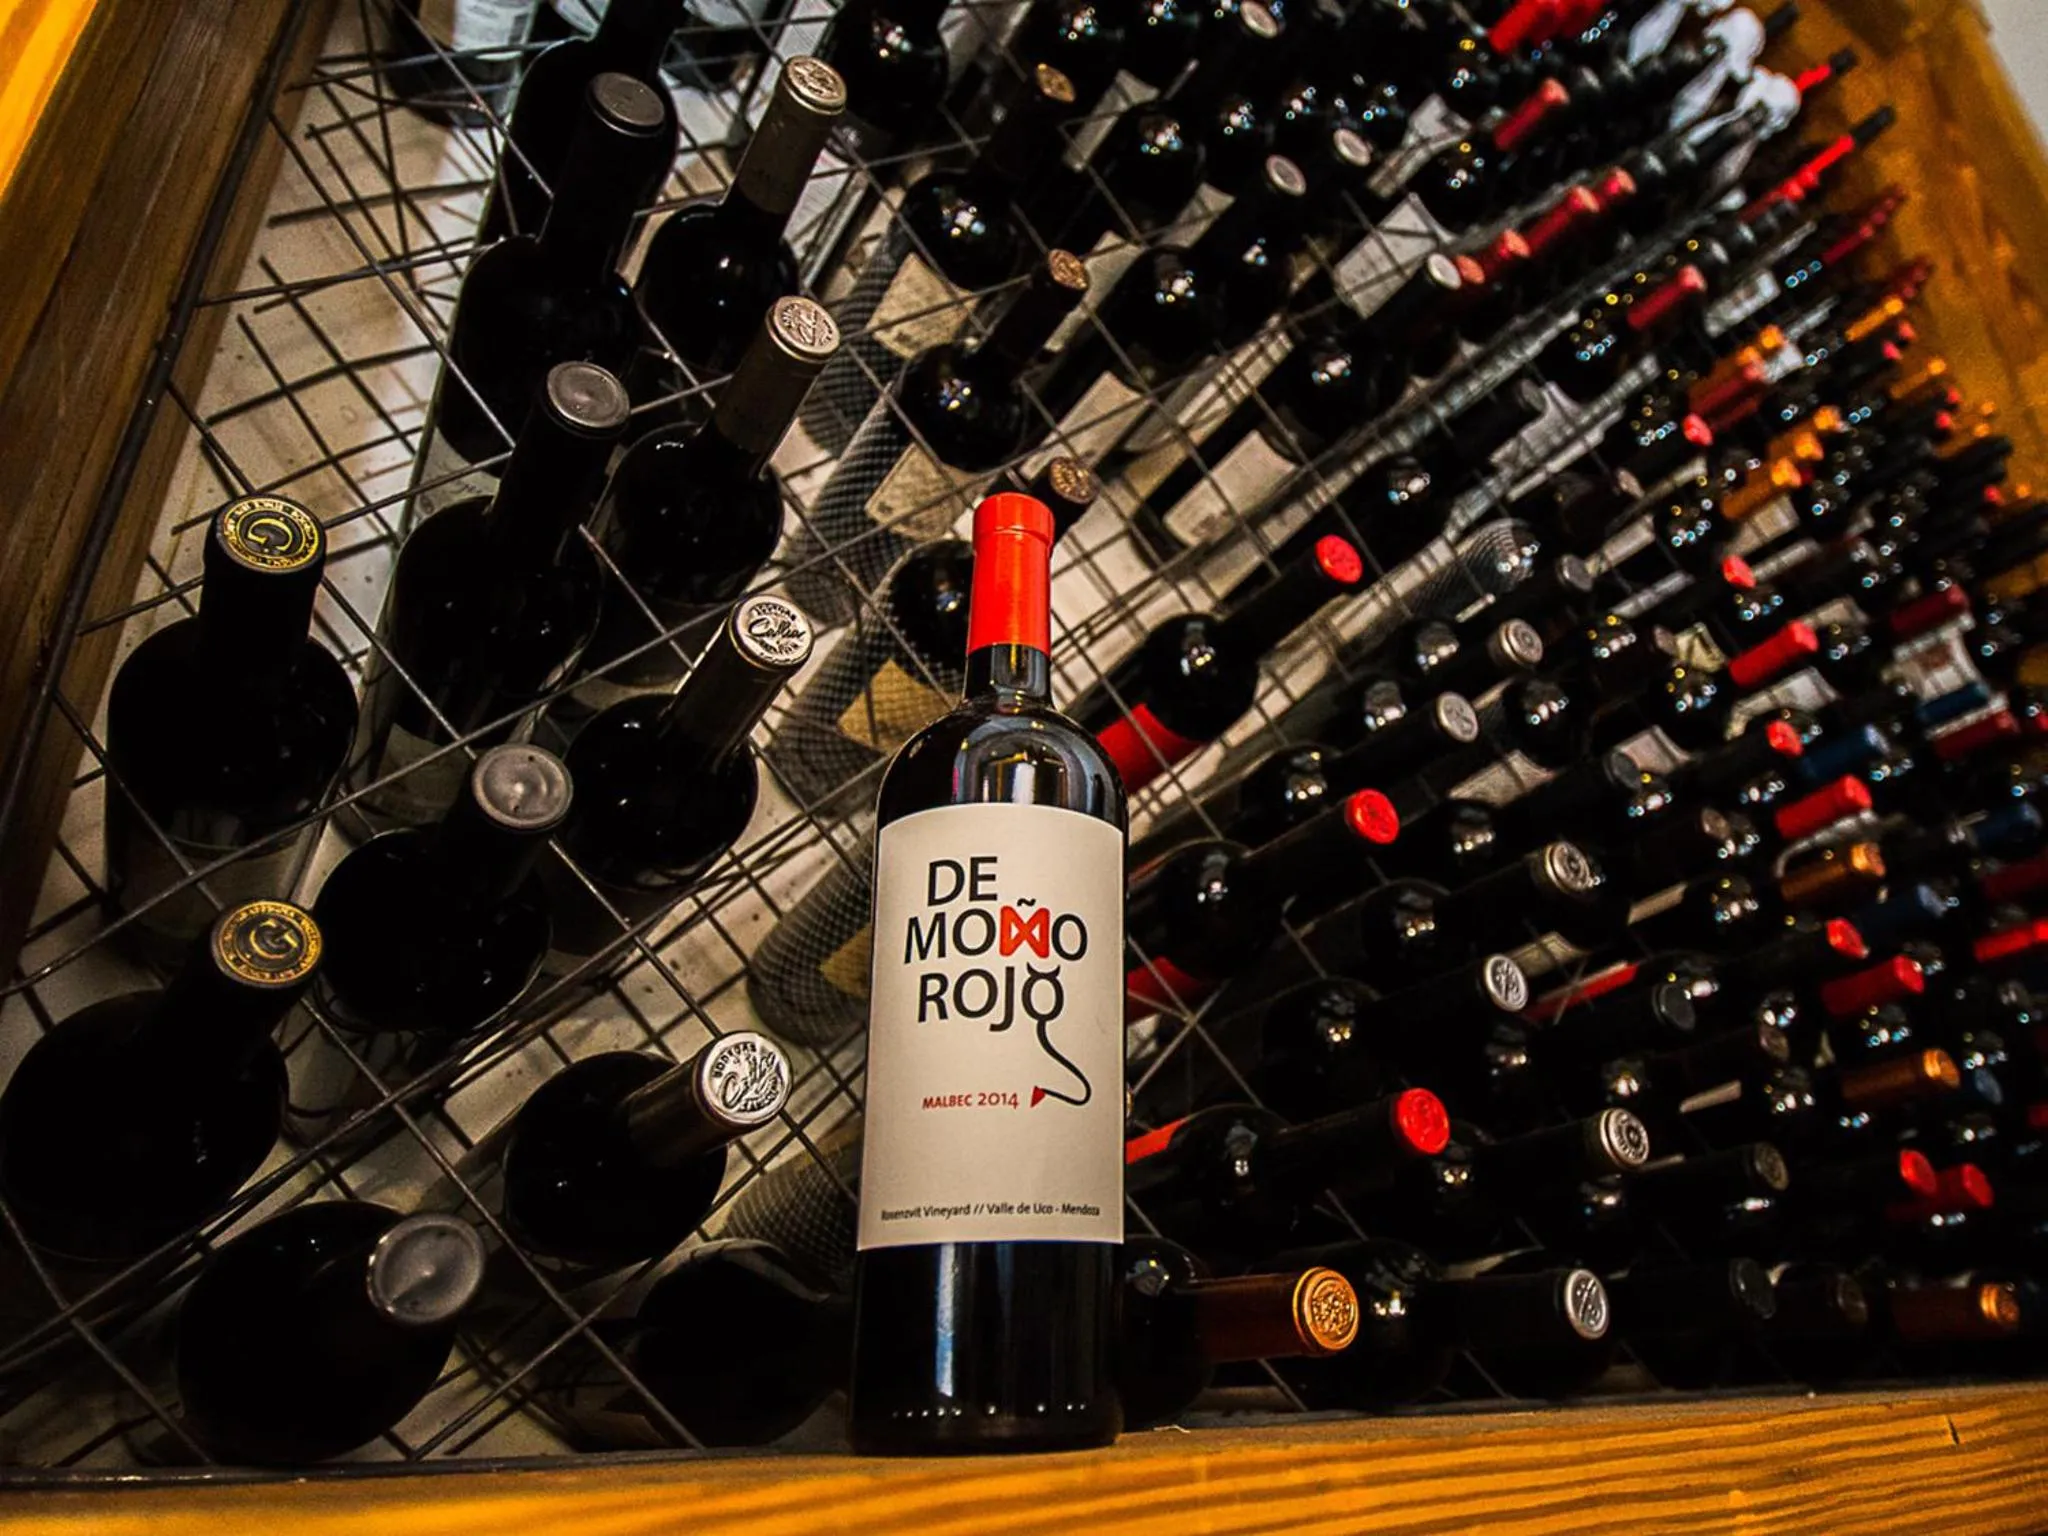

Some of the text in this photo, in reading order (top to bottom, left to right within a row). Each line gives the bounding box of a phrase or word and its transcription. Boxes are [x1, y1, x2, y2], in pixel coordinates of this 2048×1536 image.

[927, 856, 998, 907] DE
[917, 961, 1065, 1033] ROJO
[922, 1092, 1020, 1110] MALBEC 2014
[922, 1203, 971, 1221] Vineyard
[986, 1202, 1015, 1215] Valle
[1016, 1202, 1031, 1215] de
[1033, 1203, 1054, 1215] Uco
[1061, 1203, 1101, 1217] Mendoza
